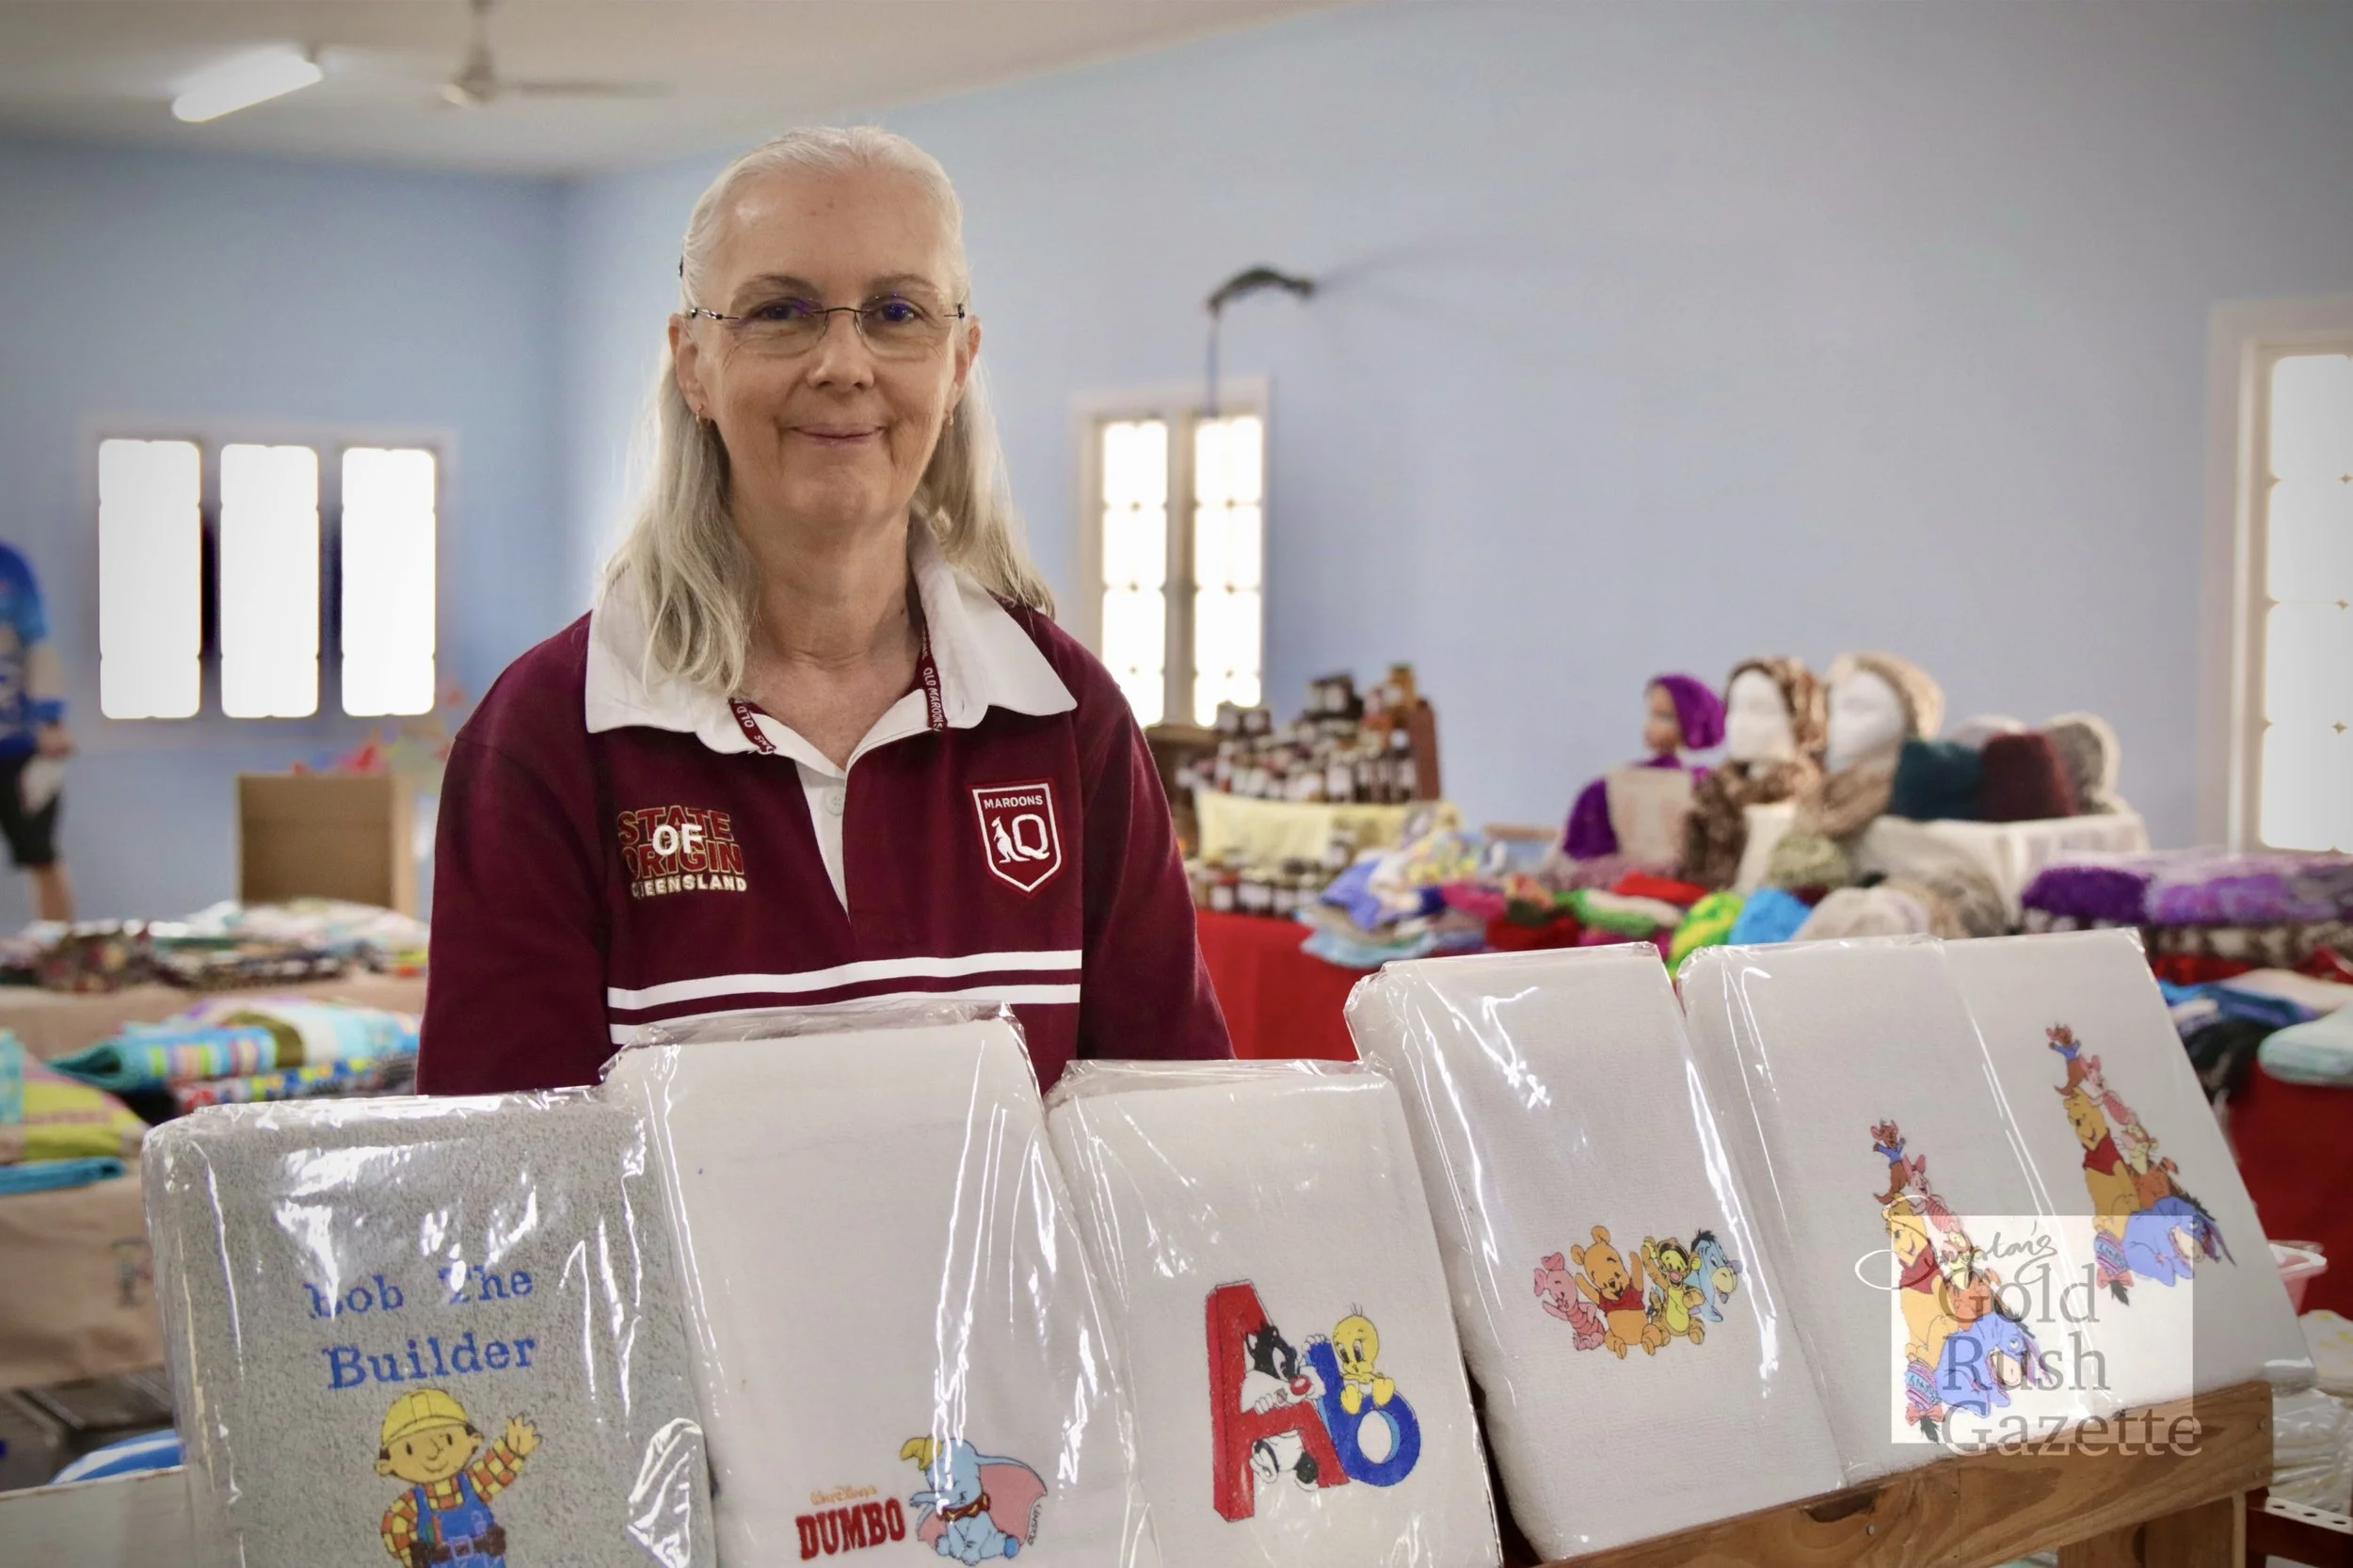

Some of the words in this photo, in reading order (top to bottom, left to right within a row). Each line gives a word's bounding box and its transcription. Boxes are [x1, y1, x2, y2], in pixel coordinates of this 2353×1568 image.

[984, 794, 1044, 809] MAROONS
[617, 805, 734, 846] STATE
[652, 823, 703, 856] OF
[622, 840, 745, 880] ORIGIN
[322, 1332, 536, 1390] Builder
[795, 1497, 906, 1560] DUMBO
